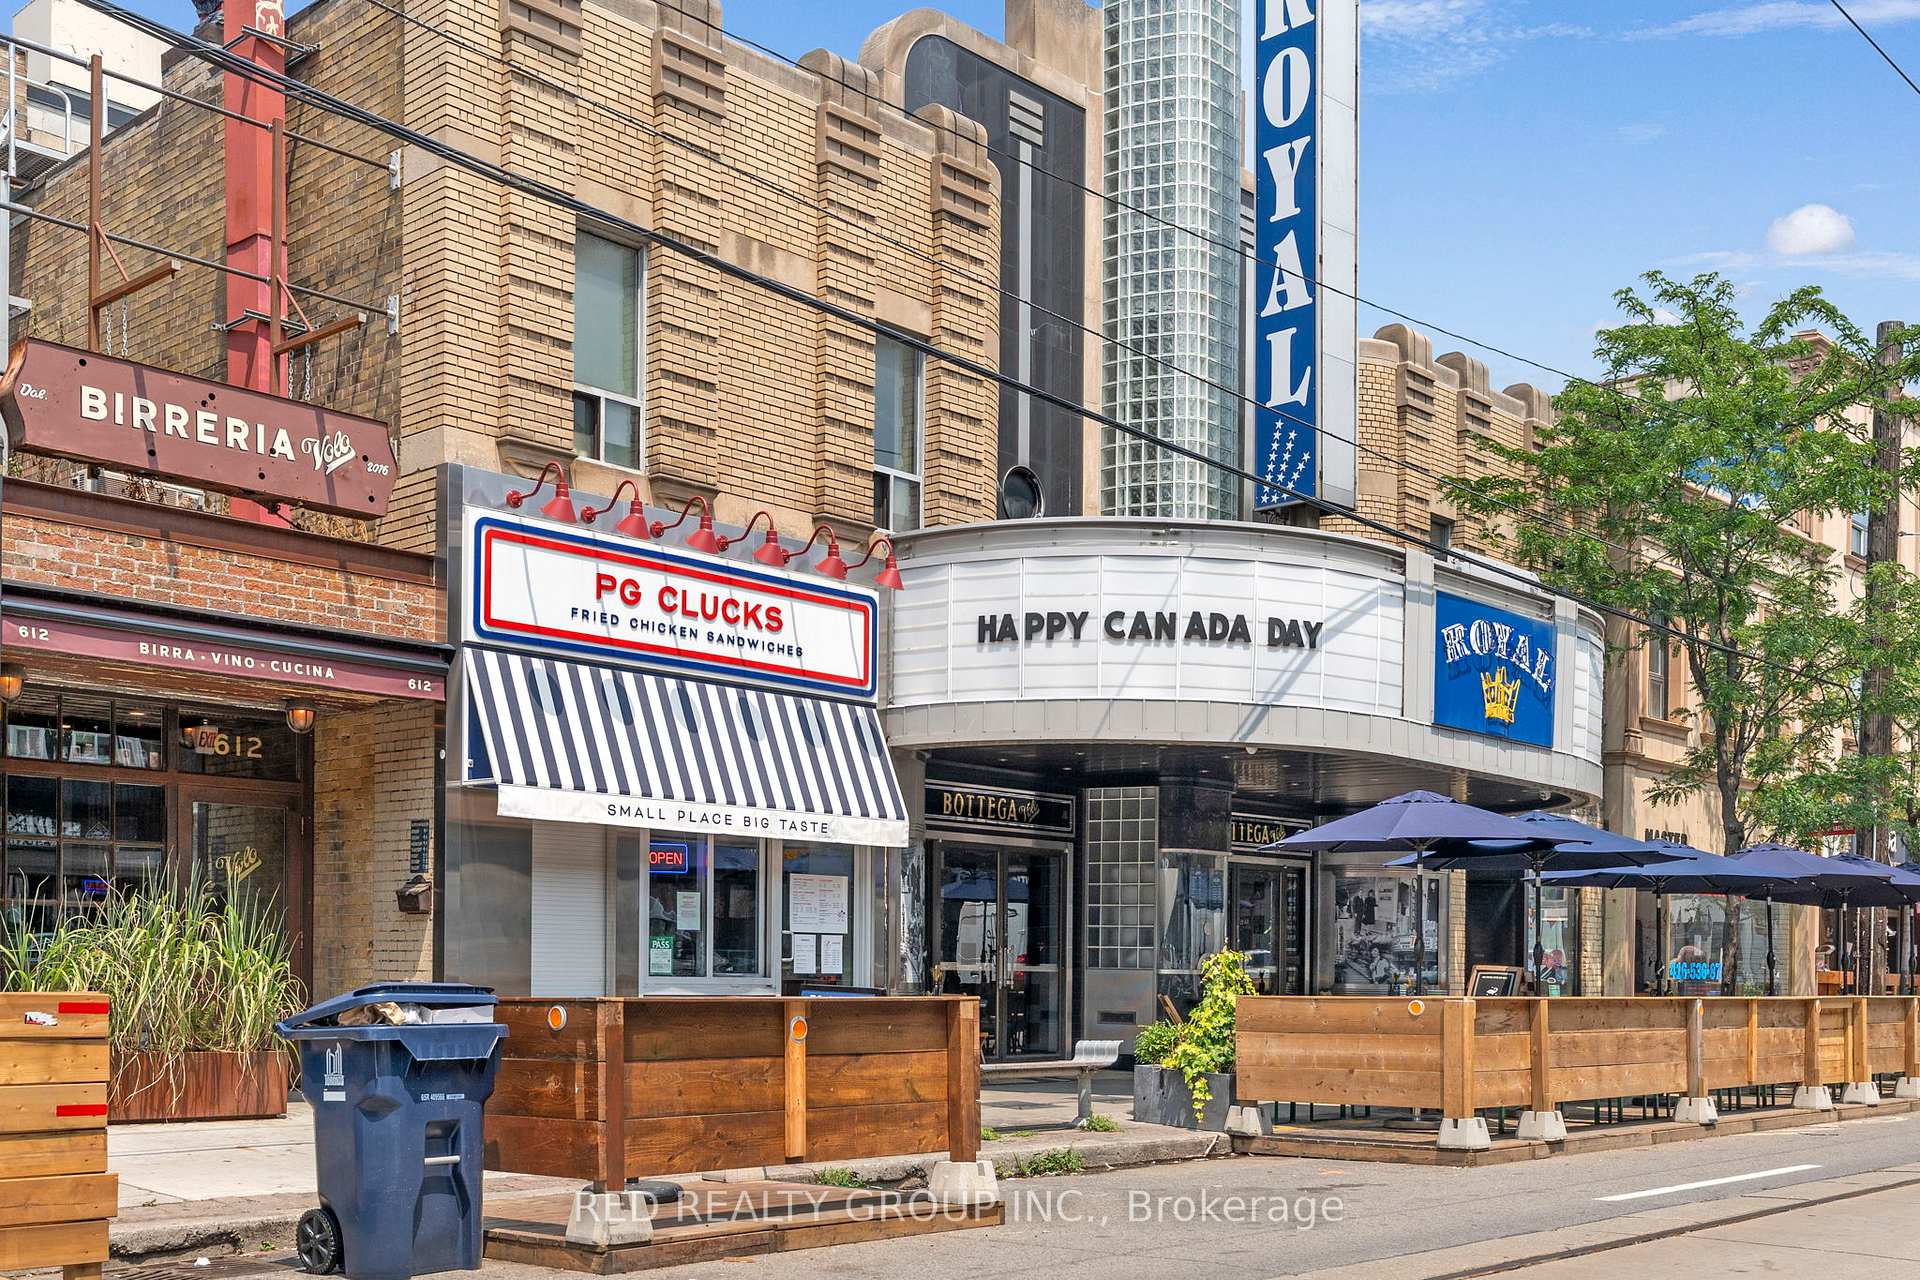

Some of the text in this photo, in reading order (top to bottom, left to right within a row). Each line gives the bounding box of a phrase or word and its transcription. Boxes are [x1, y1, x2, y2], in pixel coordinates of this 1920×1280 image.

[80, 385, 296, 462] BIRRERIA
[301, 430, 357, 475] Volo
[367, 462, 389, 476] 2016
[596, 572, 784, 633] PG CLUCKS
[18, 626, 49, 641] 612
[571, 607, 803, 658] FRIED CHICKEN SANDWICHES
[978, 611, 1323, 649] HAPPY CANADA DAY
[139, 642, 335, 679] BIRRA VINO CUCINA
[1441, 619, 1553, 693] ROYAL
[408, 678, 432, 692] 612
[214, 733, 263, 759] 612
[607, 803, 829, 834] SMALL PLACE BIG TASTE
[943, 792, 1018, 821] BOTTEGA
[1231, 822, 1270, 844] TTEGA
[649, 851, 683, 865] OPEN
[652, 940, 670, 949] PASS
